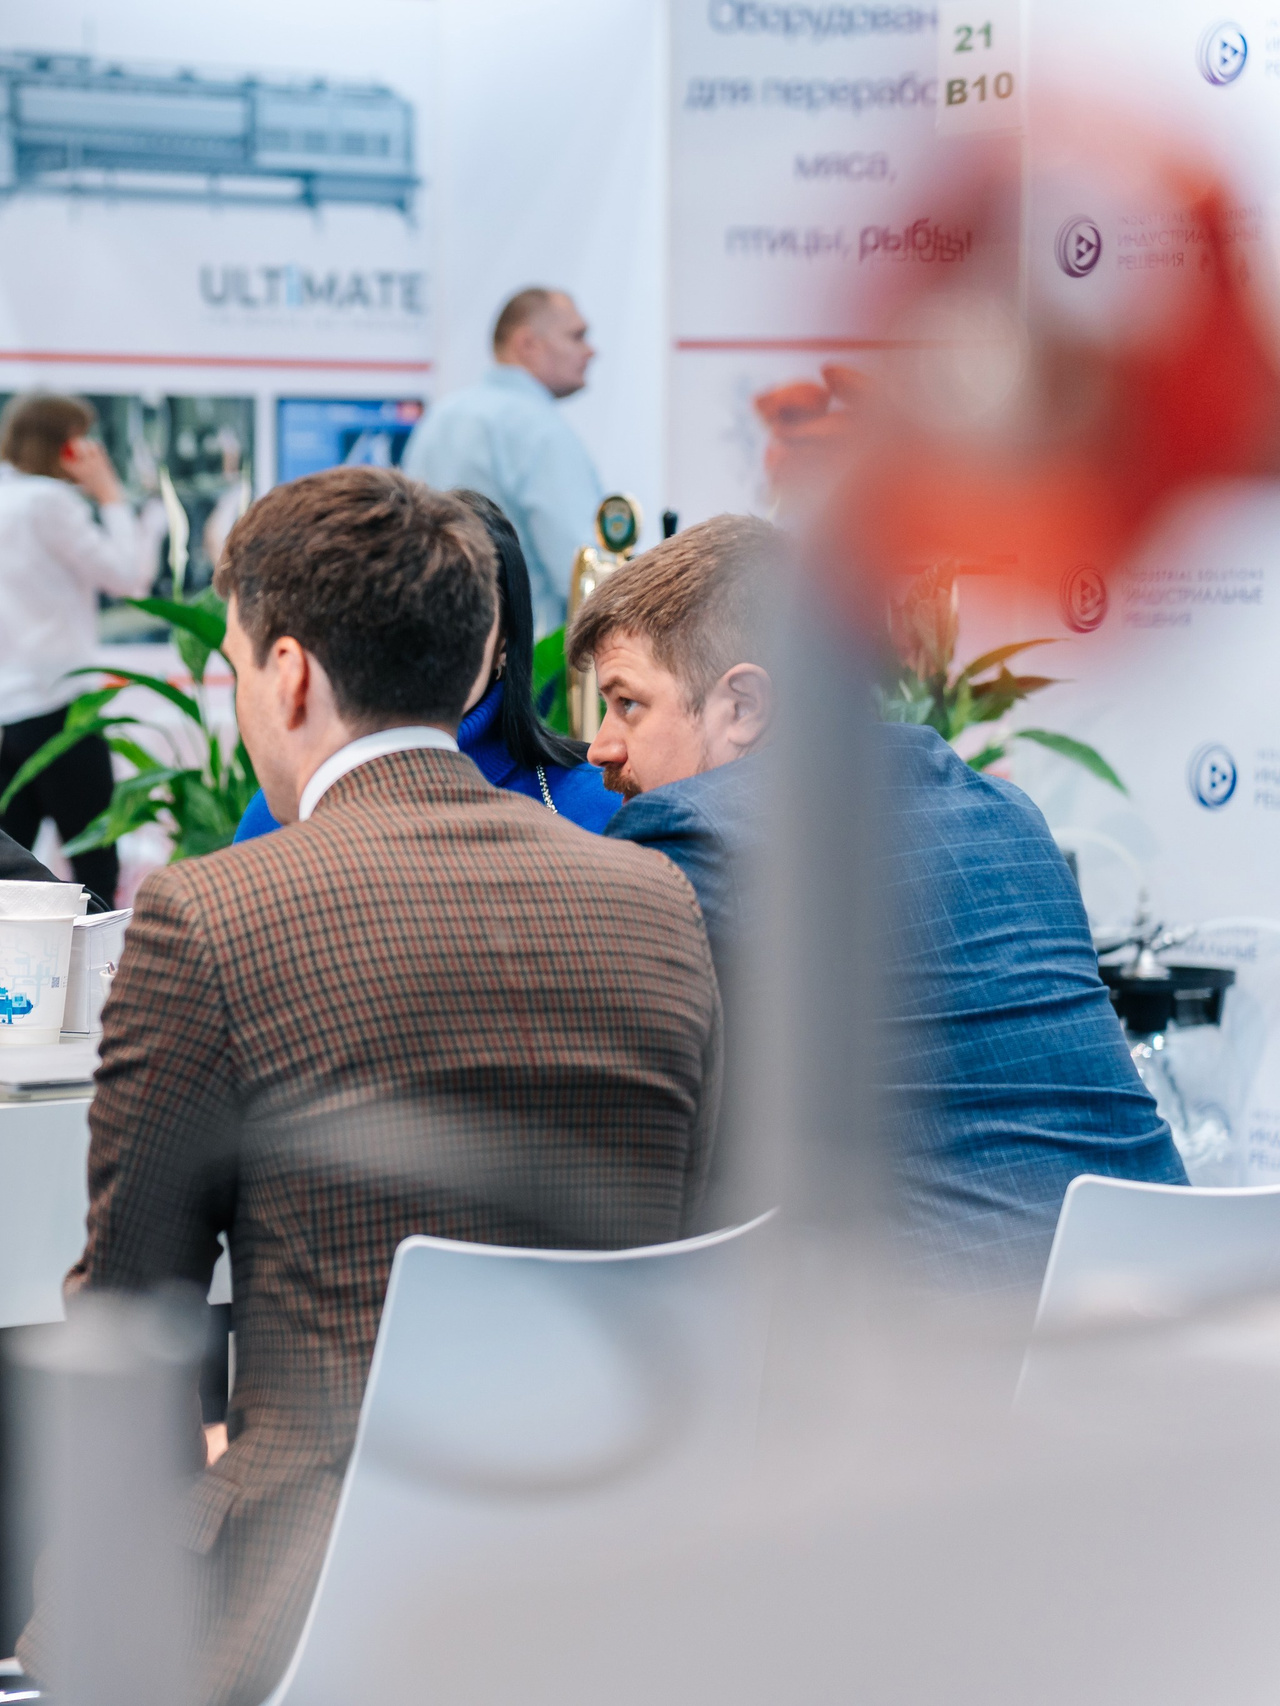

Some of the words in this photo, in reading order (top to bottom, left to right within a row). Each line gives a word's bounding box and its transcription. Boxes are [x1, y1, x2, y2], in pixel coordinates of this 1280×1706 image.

[708, 0, 938, 43] Оборудован
[954, 21, 993, 53] 21
[761, 70, 937, 117] перерабо
[945, 71, 1015, 107] B10
[1117, 226, 1264, 248] ИНДУСТРИАЬНЫЕ
